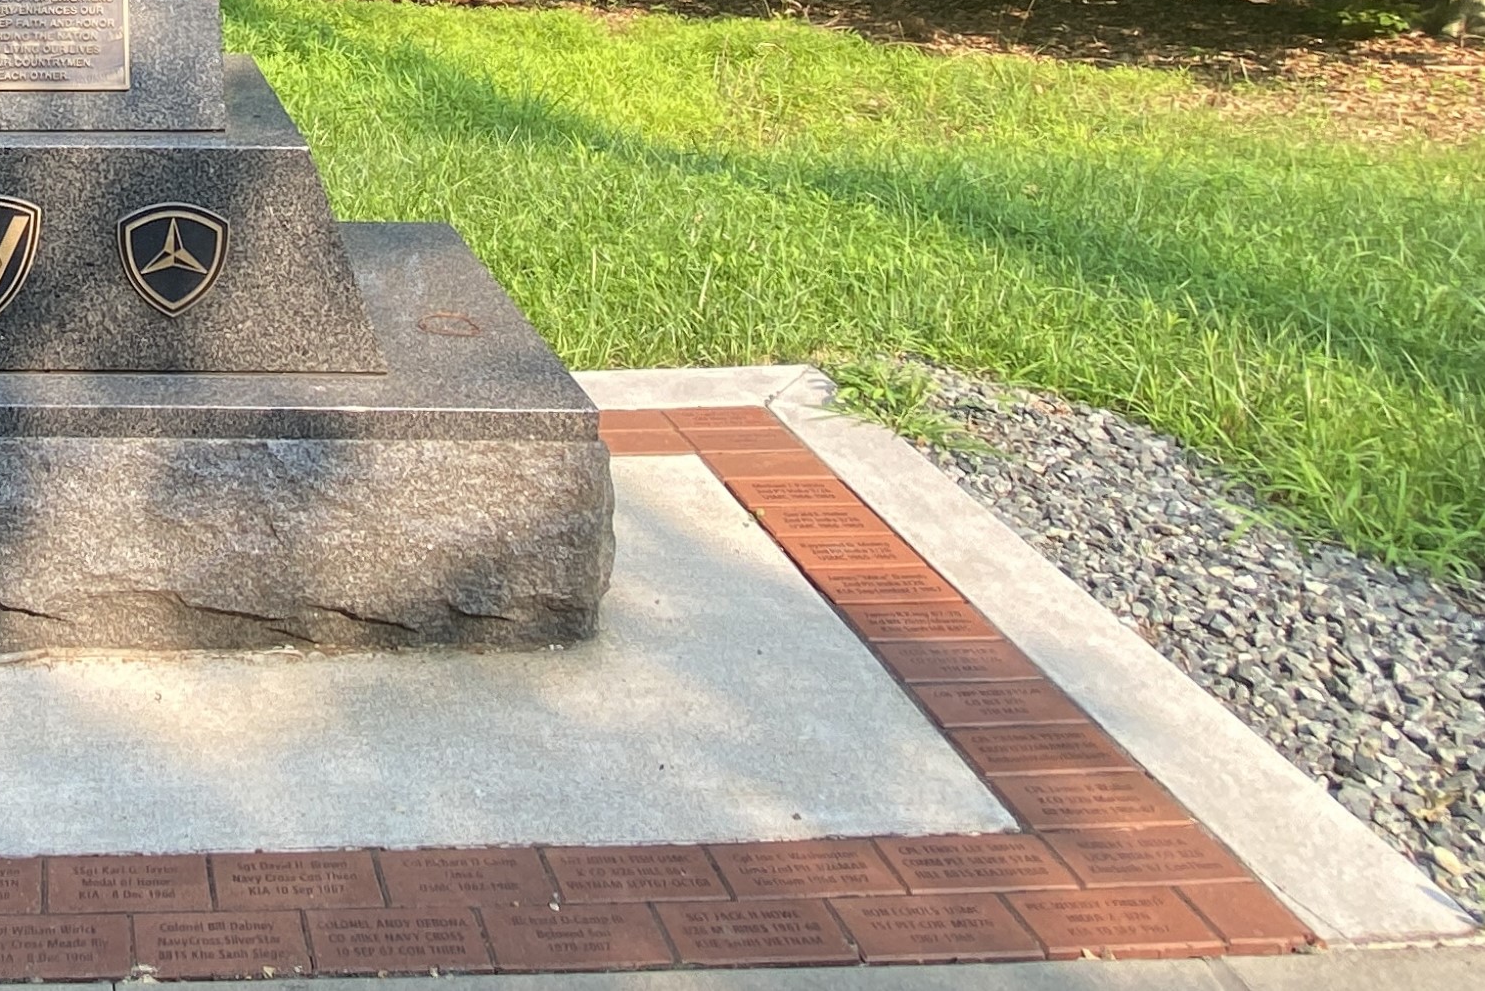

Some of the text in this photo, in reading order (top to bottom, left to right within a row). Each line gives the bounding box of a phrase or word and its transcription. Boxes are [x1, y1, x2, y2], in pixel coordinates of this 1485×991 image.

[18, 6, 79, 17] ENHANCES
[80, 5, 105, 17] OUR
[15, 19, 47, 29] FAITH
[50, 18, 74, 29] AND
[75, 18, 116, 29] HONOR
[33, 32, 54, 42] THE
[56, 31, 98, 42] NATION
[3, 44, 41, 55] LIVING
[42, 44, 66, 55] OUR
[67, 44, 101, 55] LIVES
[232, 873, 262, 884] Navy
[78, 890, 100, 900] KIA
[159, 921, 275, 933] Colonel Bill Dabney
